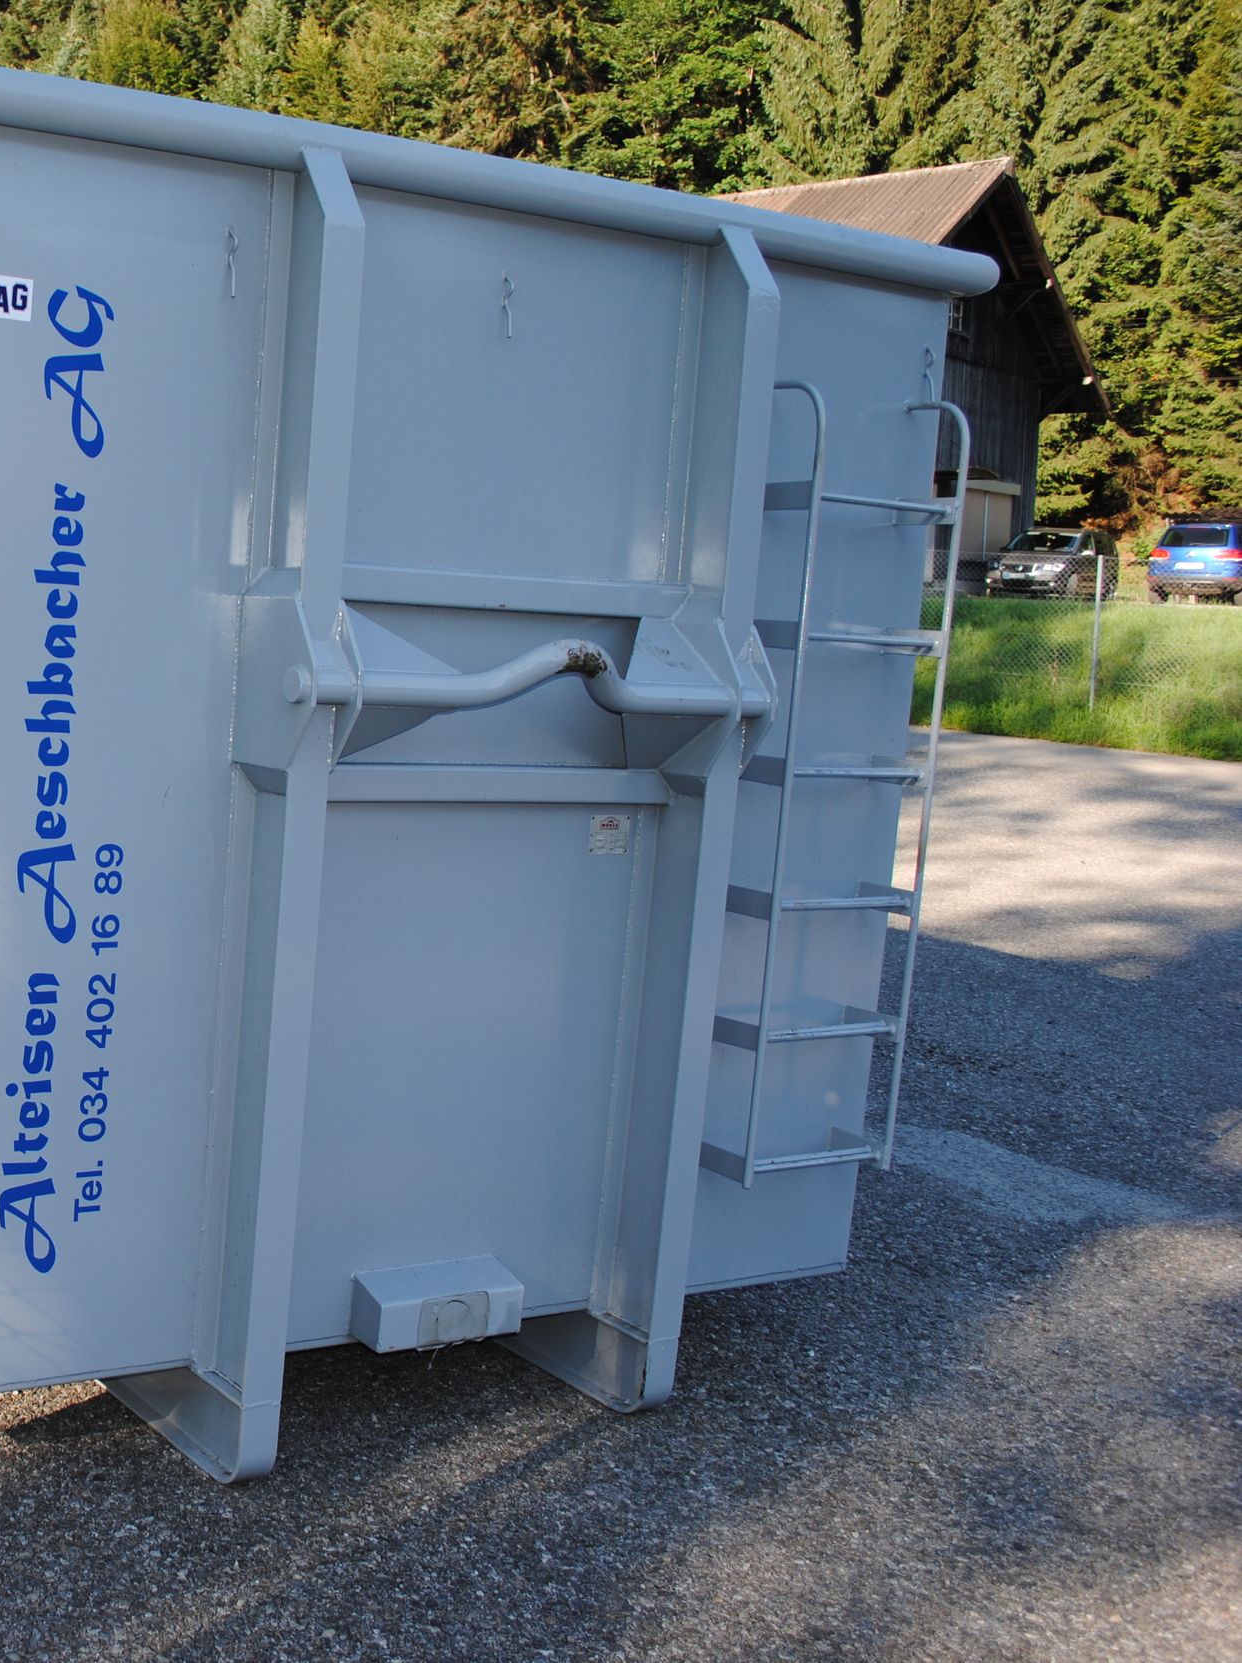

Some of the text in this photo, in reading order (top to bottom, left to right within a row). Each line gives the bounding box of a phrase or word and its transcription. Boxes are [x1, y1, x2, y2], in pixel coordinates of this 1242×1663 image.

[43, 284, 115, 459] AG
[16, 482, 87, 945] Aeschbacher
[73, 843, 124, 1223] Tel. 034 402 16 89
